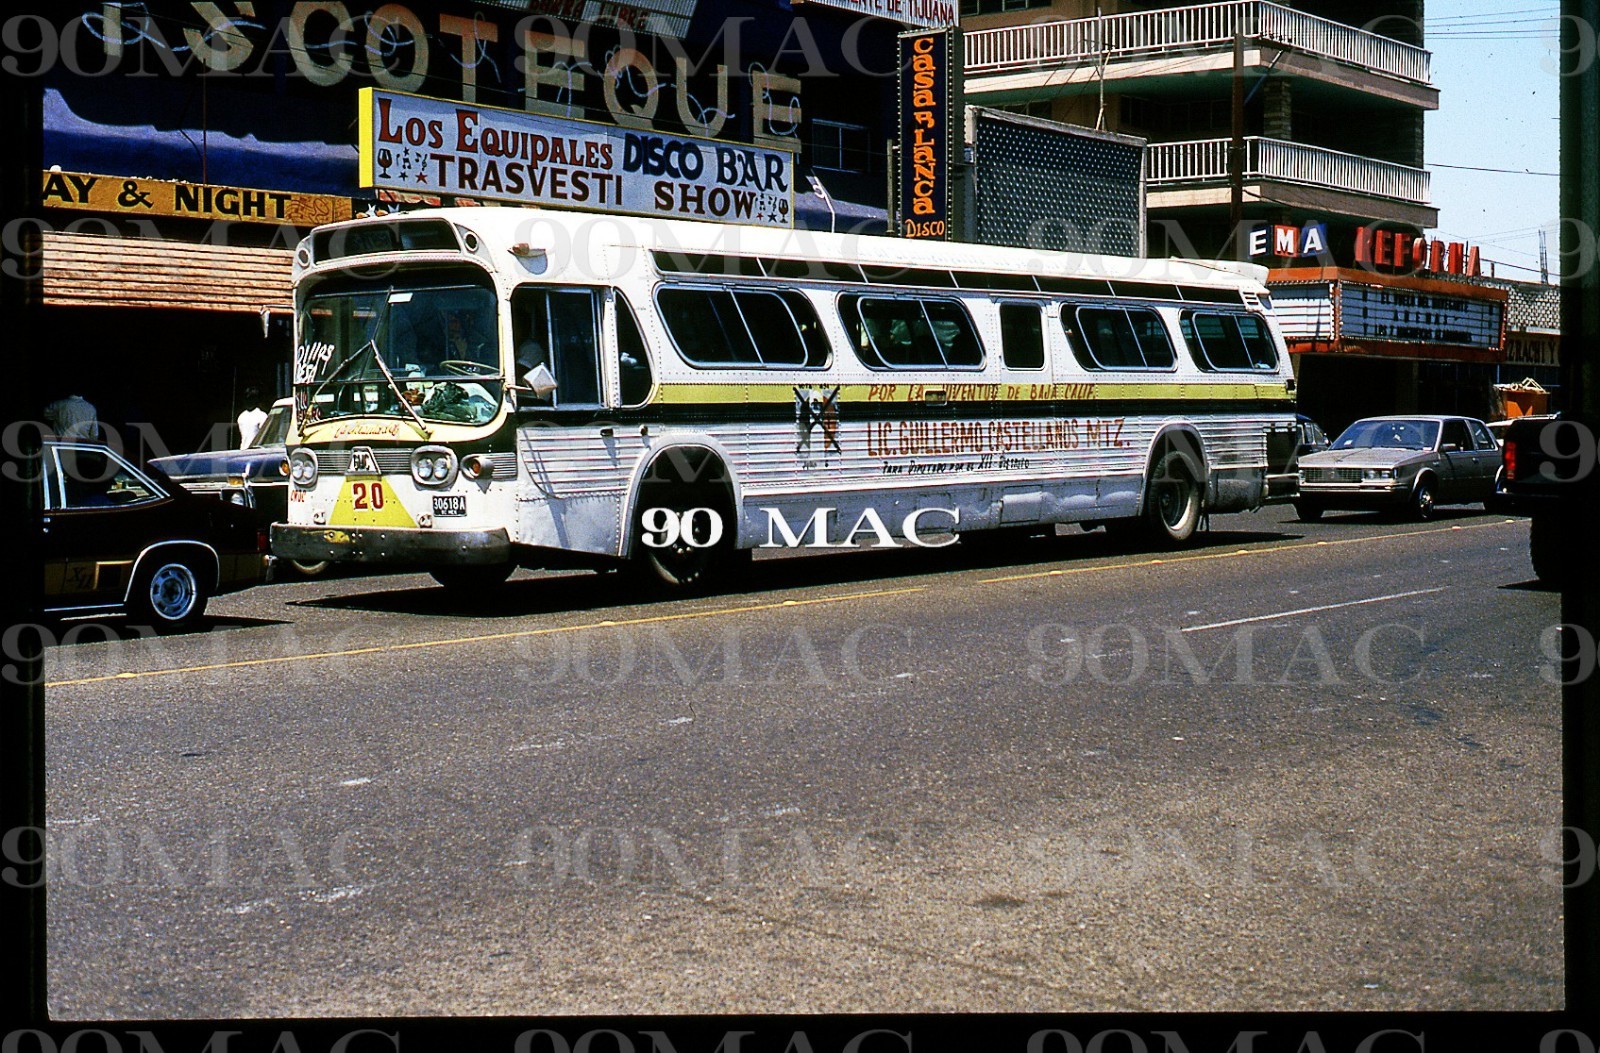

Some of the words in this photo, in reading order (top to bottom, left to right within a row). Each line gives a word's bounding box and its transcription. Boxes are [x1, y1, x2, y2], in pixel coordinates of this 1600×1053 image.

[907, 0, 955, 25] TIJUANA
[377, 97, 444, 150] LOS
[455, 108, 614, 170] EQUIPALES
[429, 152, 622, 206] TRASVESTI
[622, 132, 704, 181] DISCO
[715, 146, 789, 193] BAR
[117, 181, 154, 208] &
[174, 184, 290, 220] NIGHT
[653, 180, 758, 220] SHOW
[904, 218, 945, 239] DISCO
[1249, 226, 1324, 256] EMA
[868, 385, 896, 401] POR
[908, 385, 925, 401] LA
[1007, 386, 1021, 400] DE
[1029, 383, 1058, 400] BAJA
[899, 421, 983, 455] GUILLERMO
[987, 420, 1079, 452] CASTELLANOS
[353, 483, 383, 509] 20
